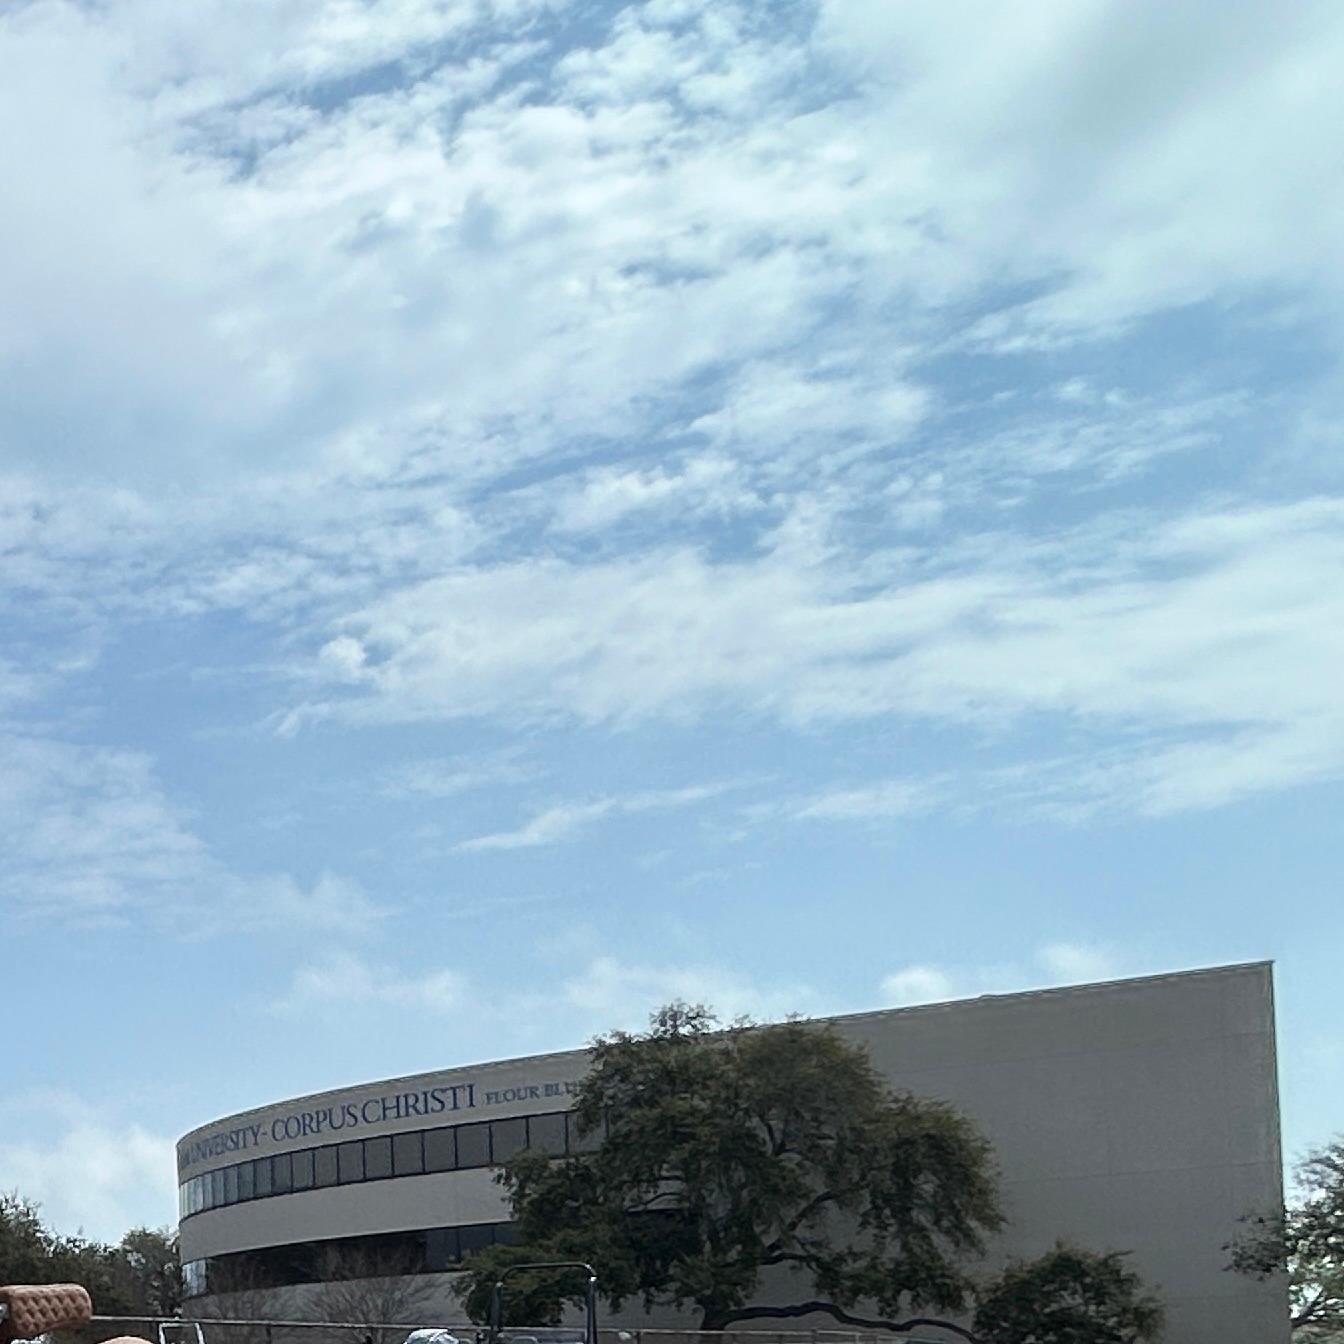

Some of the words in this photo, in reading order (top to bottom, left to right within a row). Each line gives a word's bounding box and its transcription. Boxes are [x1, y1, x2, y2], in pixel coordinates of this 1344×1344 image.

[272, 1104, 358, 1142] CORPUS
[362, 1083, 476, 1124] CHRISTI
[484, 1086, 540, 1106] FLOUR
